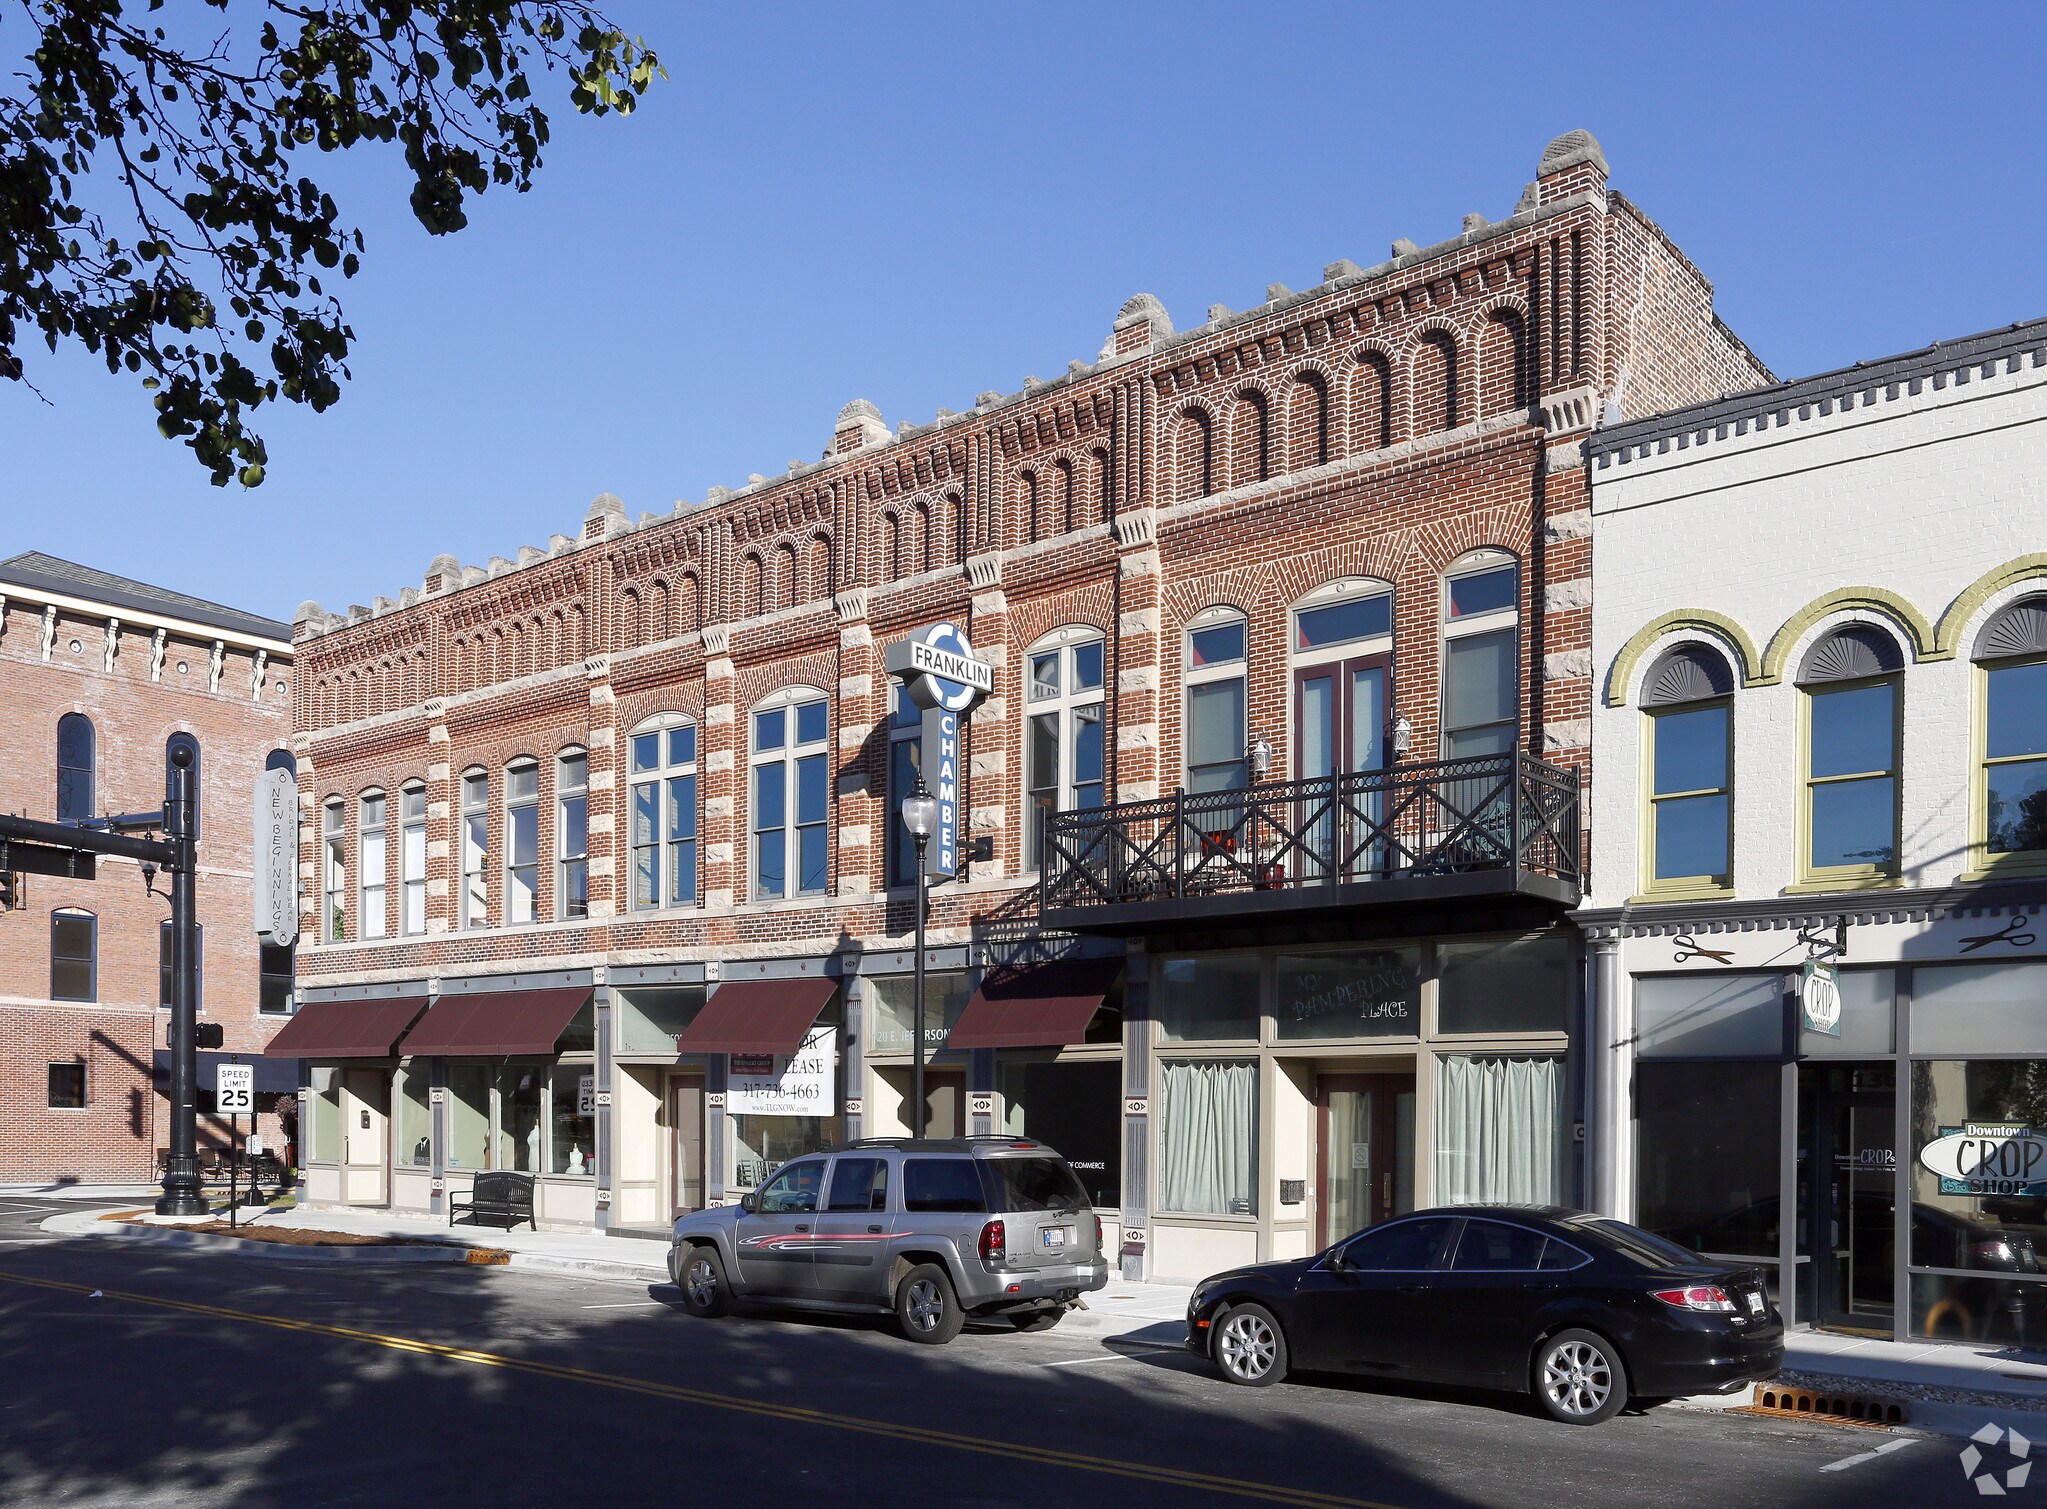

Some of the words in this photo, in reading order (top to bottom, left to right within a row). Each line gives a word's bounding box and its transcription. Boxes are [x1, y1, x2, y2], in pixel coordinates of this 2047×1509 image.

[915, 646, 988, 686] FRANKLIN
[939, 715, 954, 869] CHAMBER
[272, 788, 284, 820] NEW
[287, 800, 295, 838] BRIDAL
[272, 824, 282, 931] BEGINNINGS
[1811, 979, 1834, 1018] CROP
[1360, 1000, 1408, 1019] PLACE
[1815, 1017, 1831, 1034] SHOP
[799, 1034, 818, 1050] OR
[221, 1070, 250, 1079] SPEED
[784, 1058, 825, 1074] LEASE
[224, 1080, 246, 1088] LIMIT
[743, 1082, 820, 1100] 317-736-4663
[221, 1089, 249, 1107] 25
[1967, 1124, 2031, 1137] Downtown
[1074, 1161, 1105, 1170] COMMERCE
[1956, 1139, 2044, 1179] CROP
[1970, 1178, 2029, 1196] SHOP
